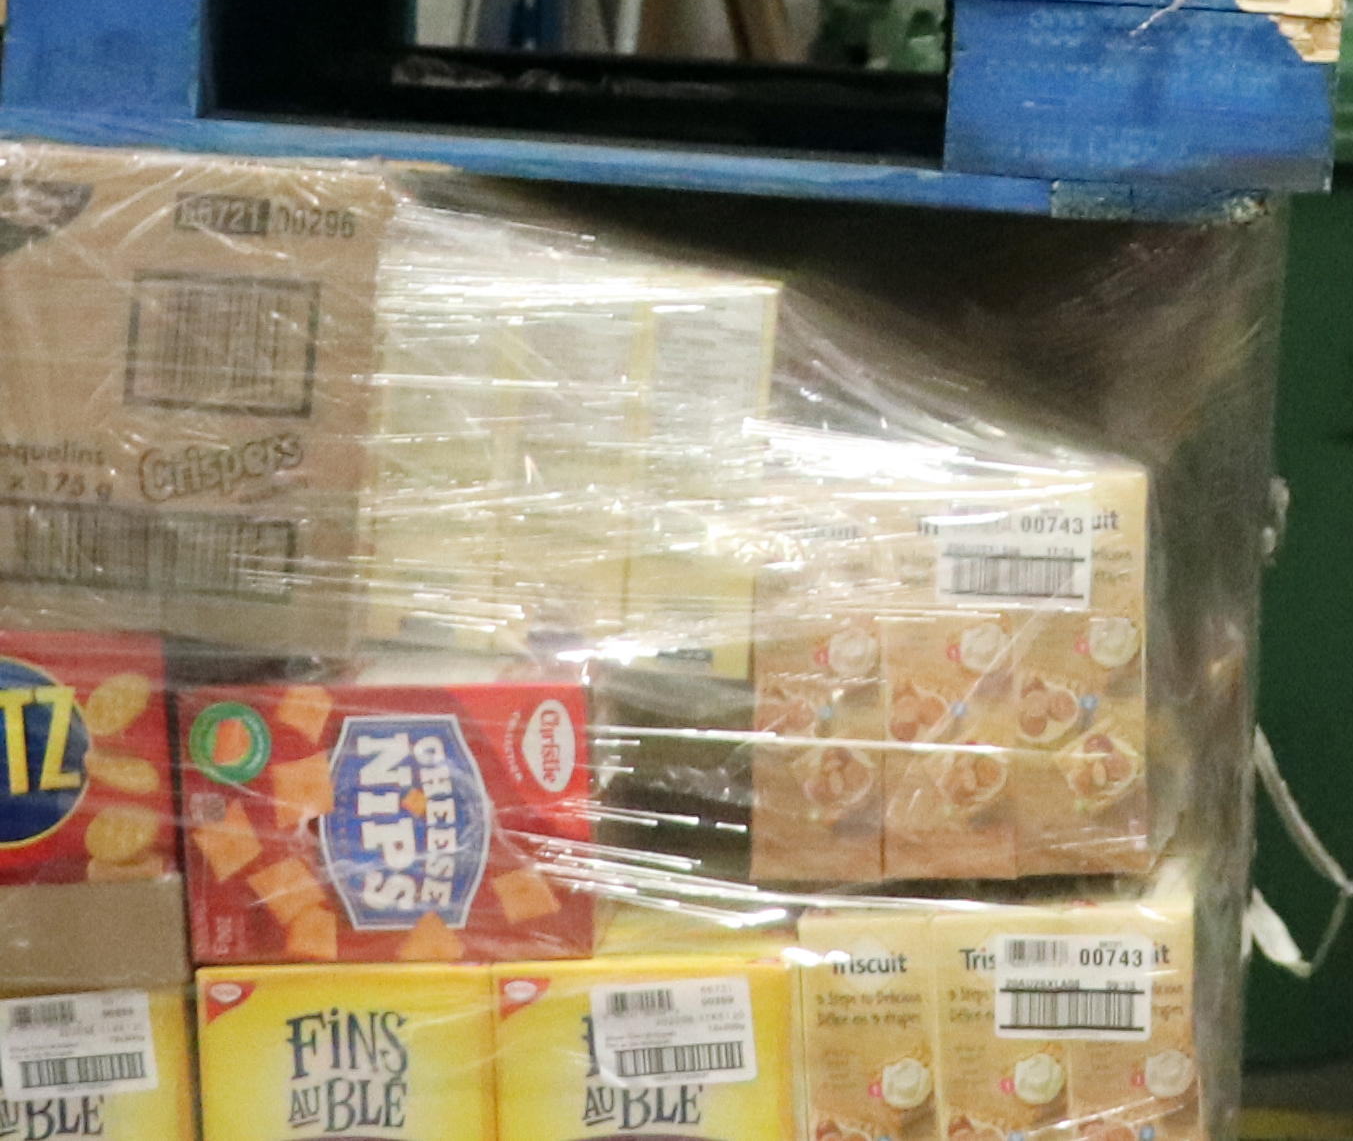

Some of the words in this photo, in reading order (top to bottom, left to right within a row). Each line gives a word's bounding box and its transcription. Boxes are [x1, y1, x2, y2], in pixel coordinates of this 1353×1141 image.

[1020, 515, 1084, 535] 00743
[0, 685, 81, 796] TZ
[535, 708, 563, 785] Christie
[355, 731, 419, 910] NIPS
[412, 735, 457, 908] CHEESE
[1079, 947, 1145, 968] 00743
[288, 1086, 321, 1124] AU
[582, 1086, 615, 1122] AU
